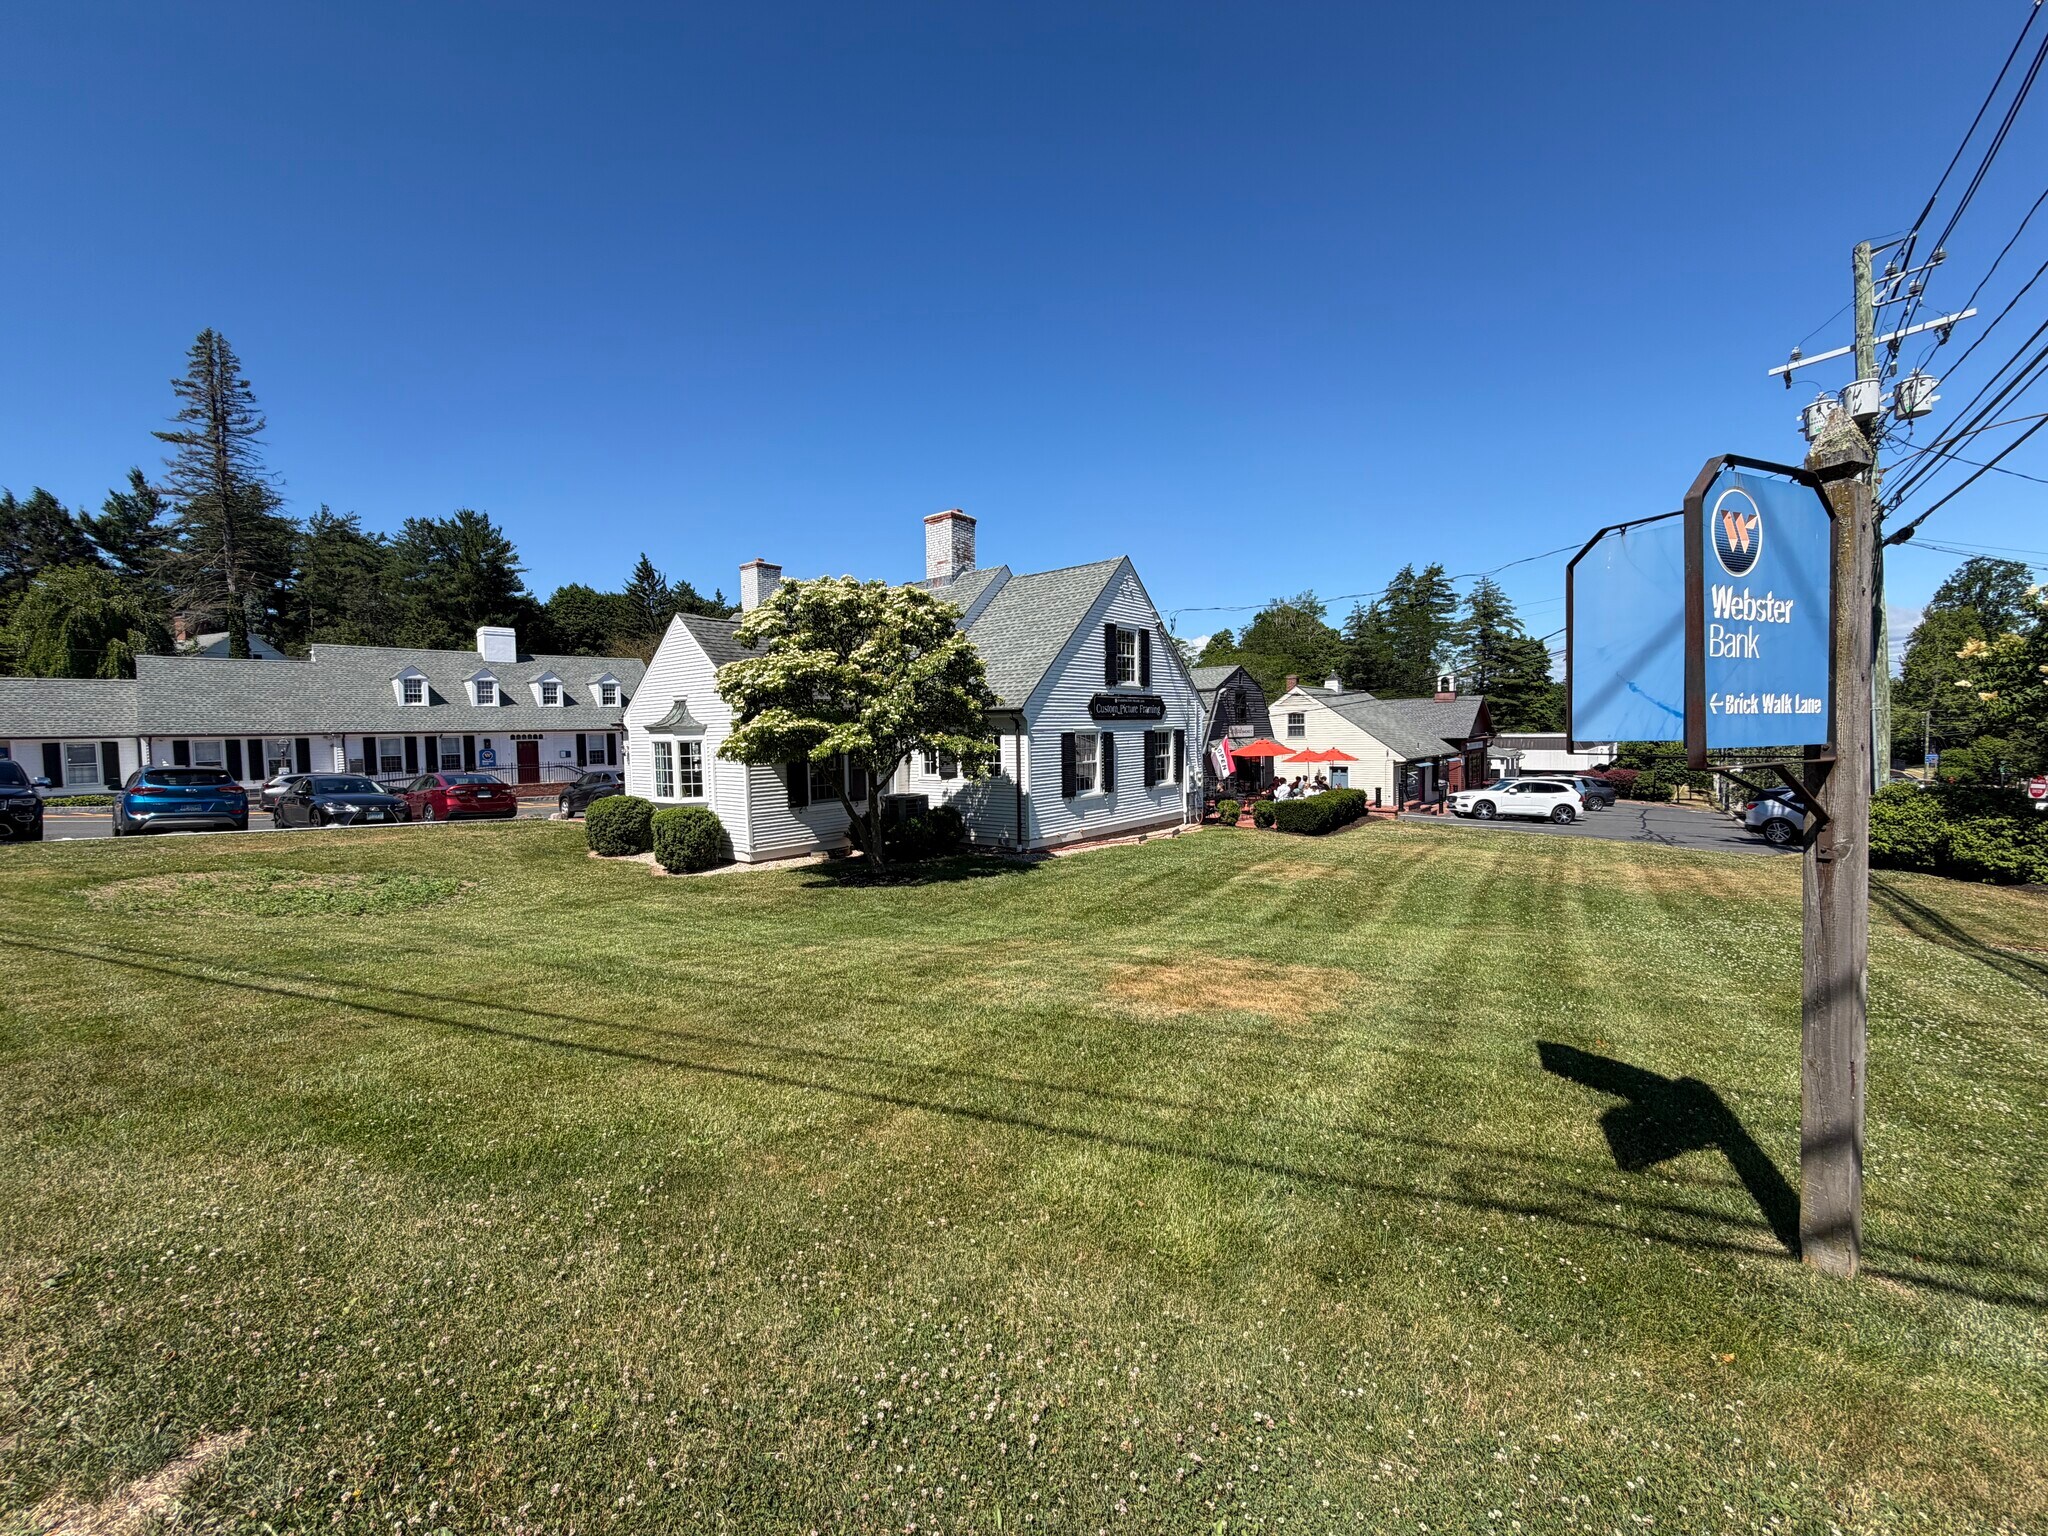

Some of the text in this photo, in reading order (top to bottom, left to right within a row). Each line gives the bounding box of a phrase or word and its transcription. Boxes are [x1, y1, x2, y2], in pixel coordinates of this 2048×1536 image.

[1711, 584, 1794, 624] Webster
[1709, 623, 1760, 659] Bank
[1096, 703, 1161, 716] Custom Picture Framing
[1725, 692, 1822, 715] Brick Walk Lane
[1216, 748, 1228, 771] OPEN
